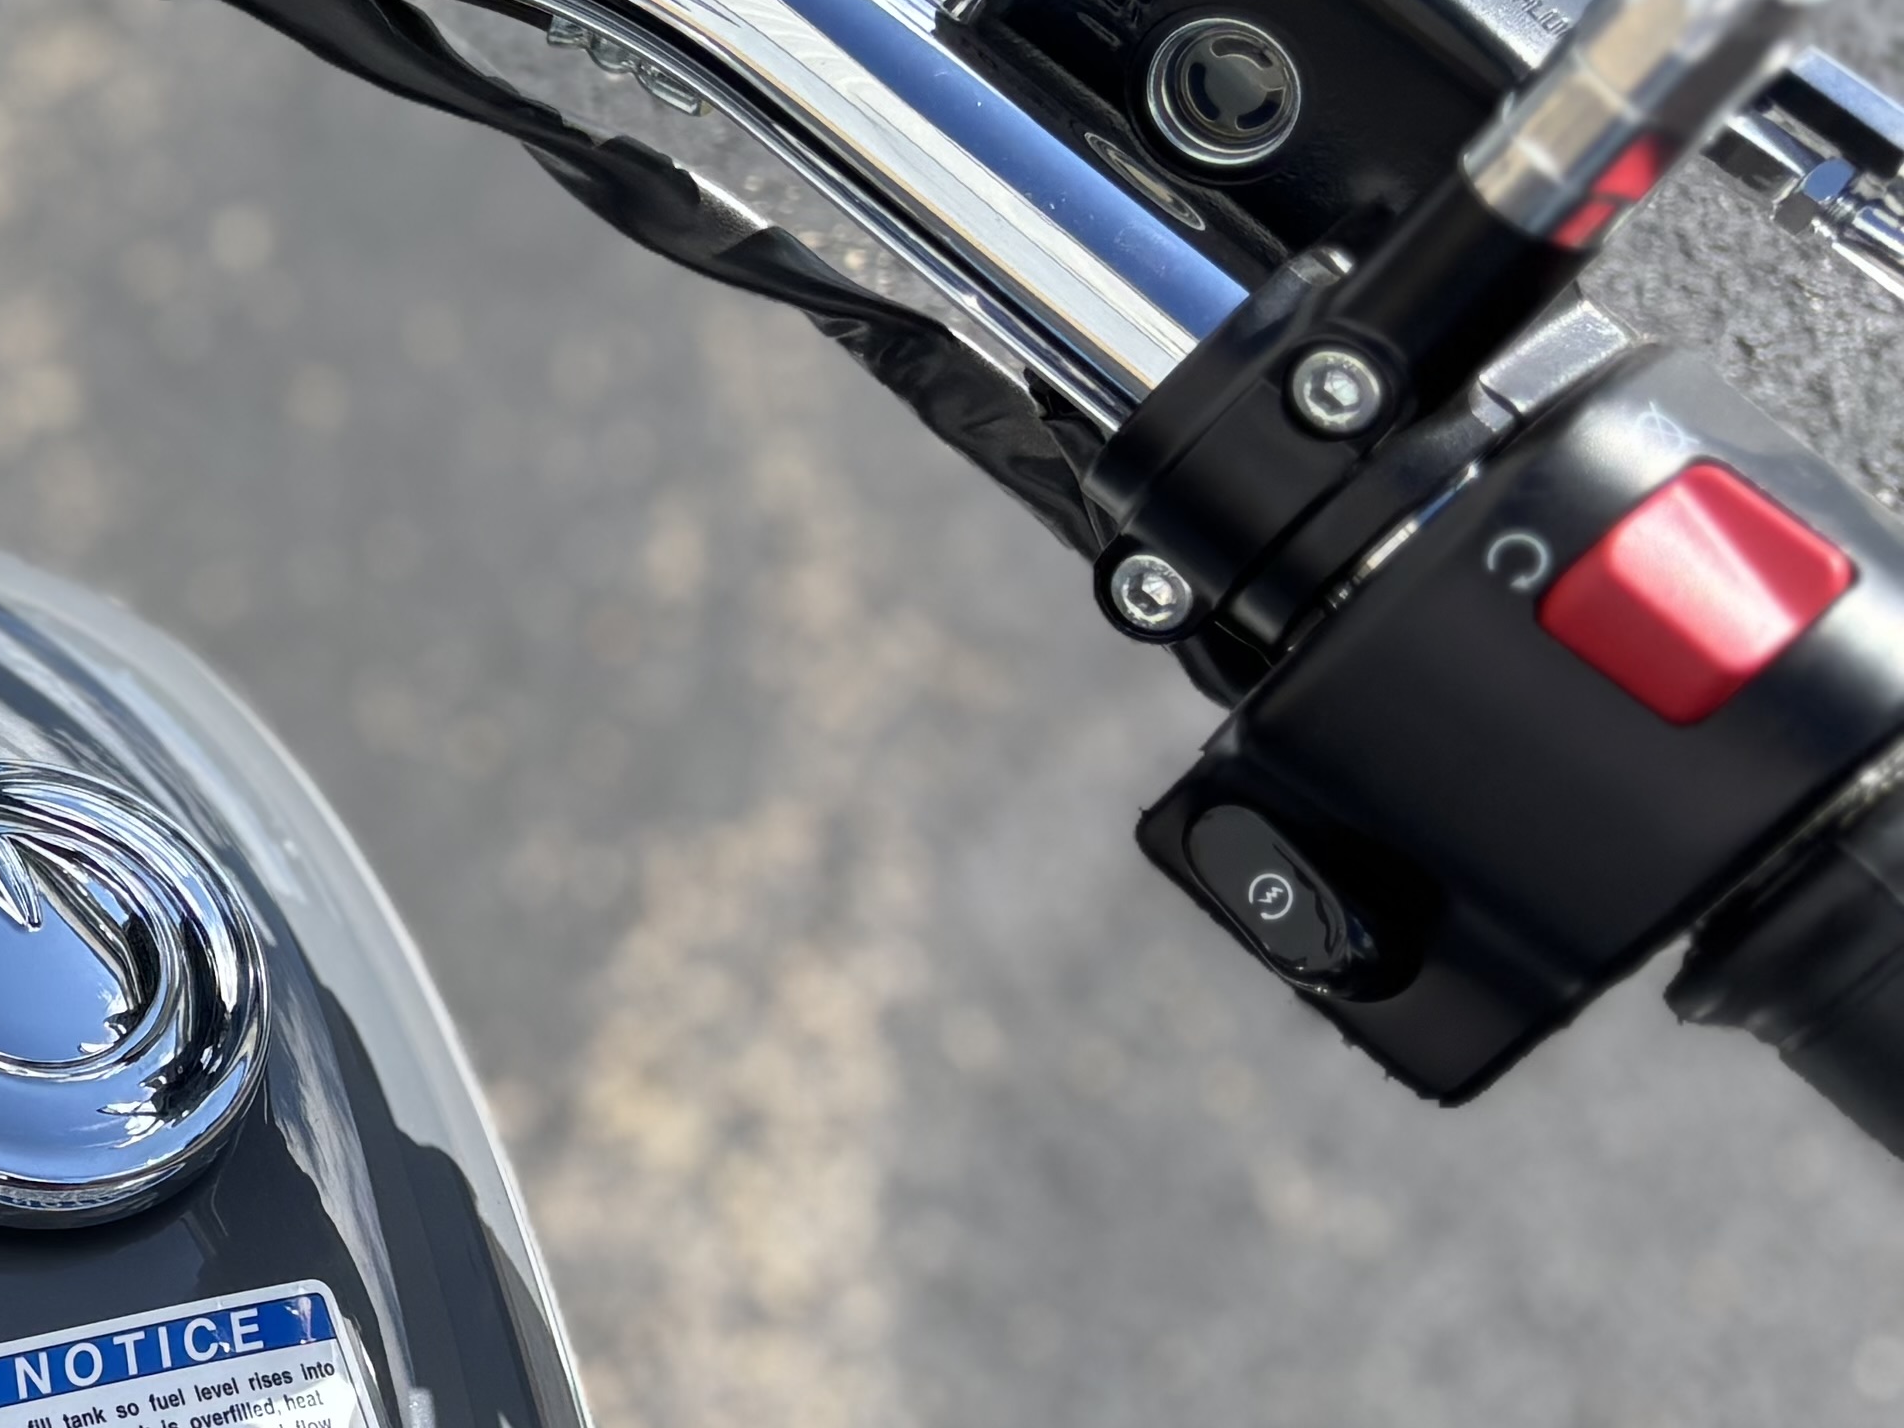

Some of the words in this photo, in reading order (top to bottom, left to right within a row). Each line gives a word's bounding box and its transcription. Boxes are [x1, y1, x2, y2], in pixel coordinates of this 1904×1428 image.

[14, 1307, 264, 1400] NOTICE
[116, 1402, 139, 1418] so
[149, 1389, 186, 1411] fuel
[195, 1378, 239, 1402] level
[248, 1370, 293, 1391] rises
[301, 1361, 335, 1380] into
[284, 1390, 324, 1411] heat
